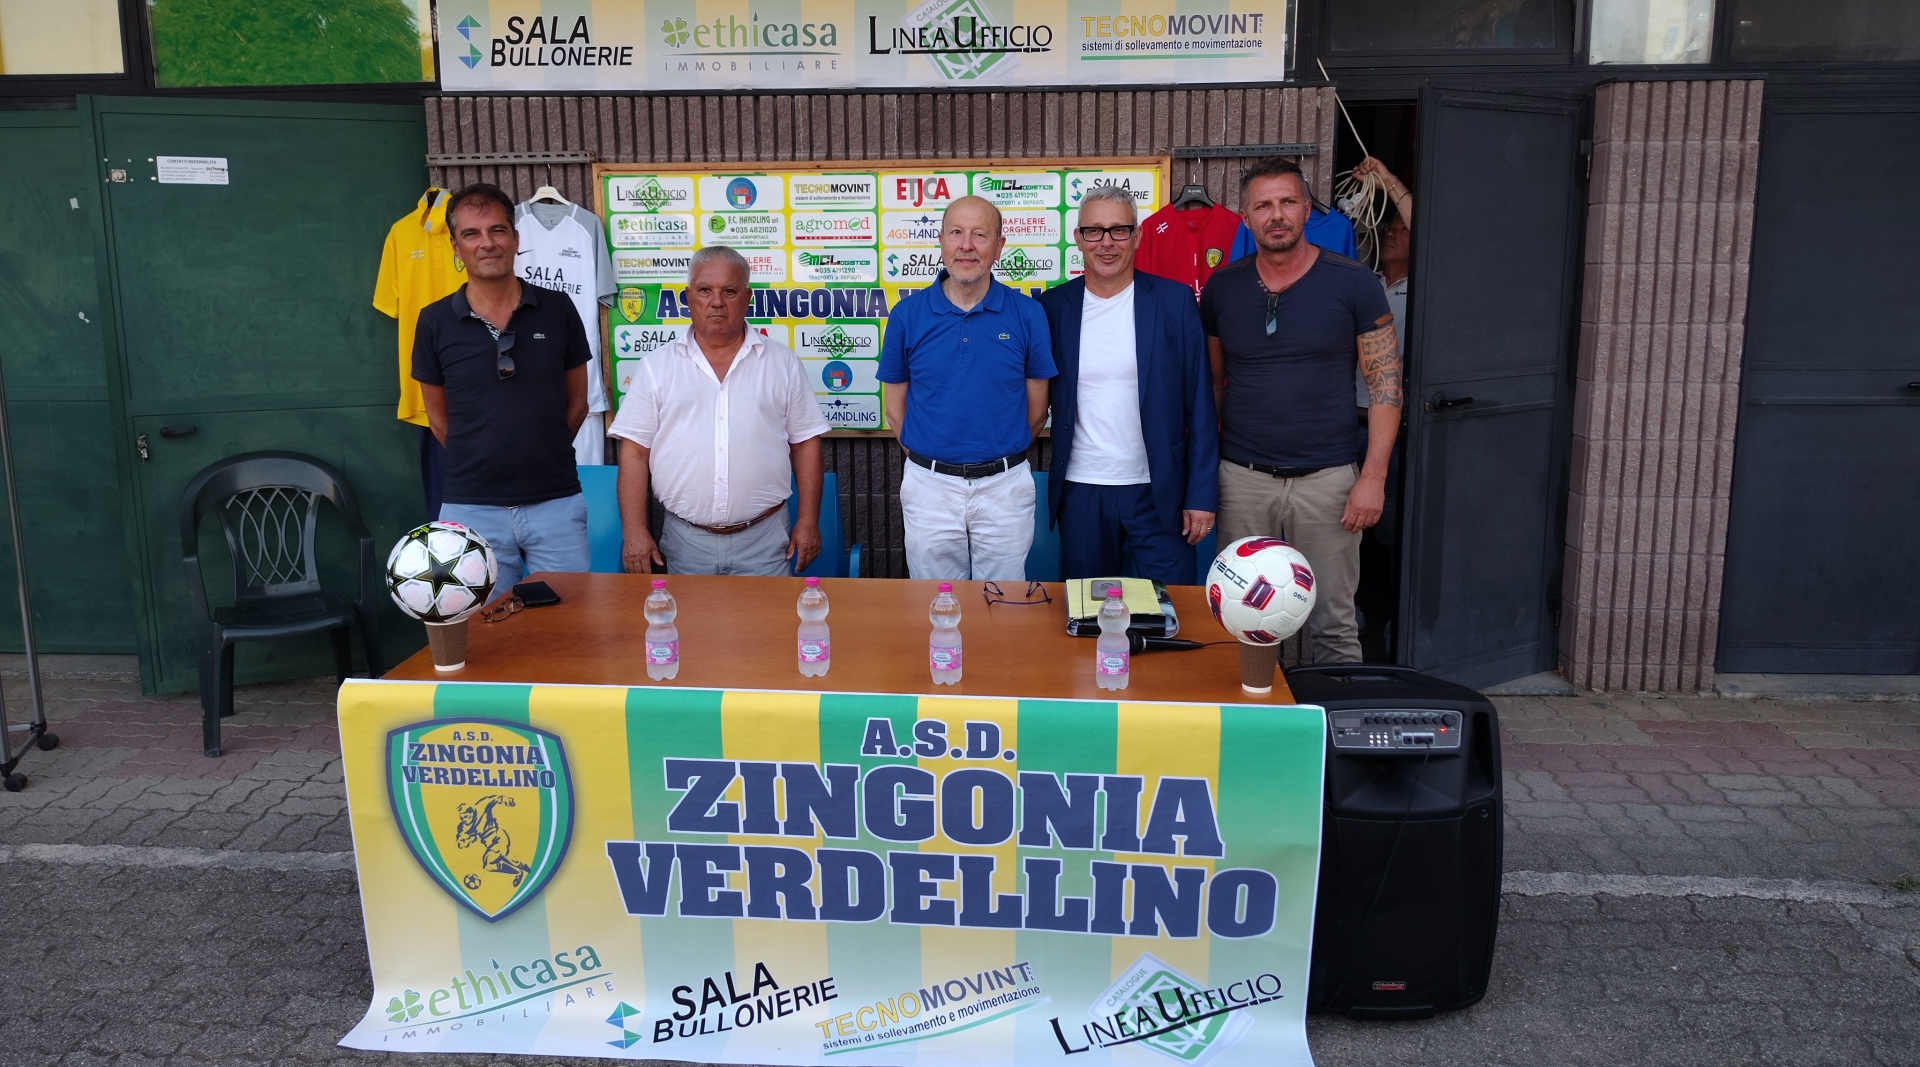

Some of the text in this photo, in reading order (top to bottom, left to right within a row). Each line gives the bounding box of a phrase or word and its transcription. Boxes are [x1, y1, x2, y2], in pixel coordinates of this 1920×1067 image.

[505, 15, 591, 45] SALA
[693, 11, 838, 48] ethicasa
[1081, 13, 1264, 37] TECNOMOVINT
[491, 38, 634, 67] BULLONERIE
[1081, 37, 1263, 51] sistemi di sollevamento e movimentazione
[664, 60, 838, 72] IMMOBILIARE
[794, 183, 871, 194] TECNOMOVINT
[629, 216, 688, 231] ethicasa
[739, 215, 771, 224] HANDLING
[795, 217, 871, 233] agromed
[1002, 226, 1047, 234] ORGHETTI
[886, 229, 941, 239] AGSHAND
[524, 266, 564, 282] SALA
[617, 257, 691, 268] TECNOMOVINT
[745, 288, 890, 319] INGONIA
[640, 330, 676, 343] SALA
[452, 731, 494, 742] A.S.D.
[862, 717, 1016, 762] A.S.D.
[409, 743, 545, 765] ZINGONIA
[402, 765, 556, 788] VERDELLINO
[664, 758, 1225, 859] ZINGONIA
[605, 840, 1278, 939] VERDELLINO
[428, 944, 603, 1018] ethicasa
[671, 961, 780, 1022] SALA
[1106, 967, 1149, 1008] CATALOGUE
[382, 980, 615, 1043] IMMOBILIARE
[652, 977, 839, 1044] BULLONERIE
[814, 960, 1030, 1040] TECNOMOVINT
[822, 984, 1041, 1050] sistemi di sollevamento e movimentazione
